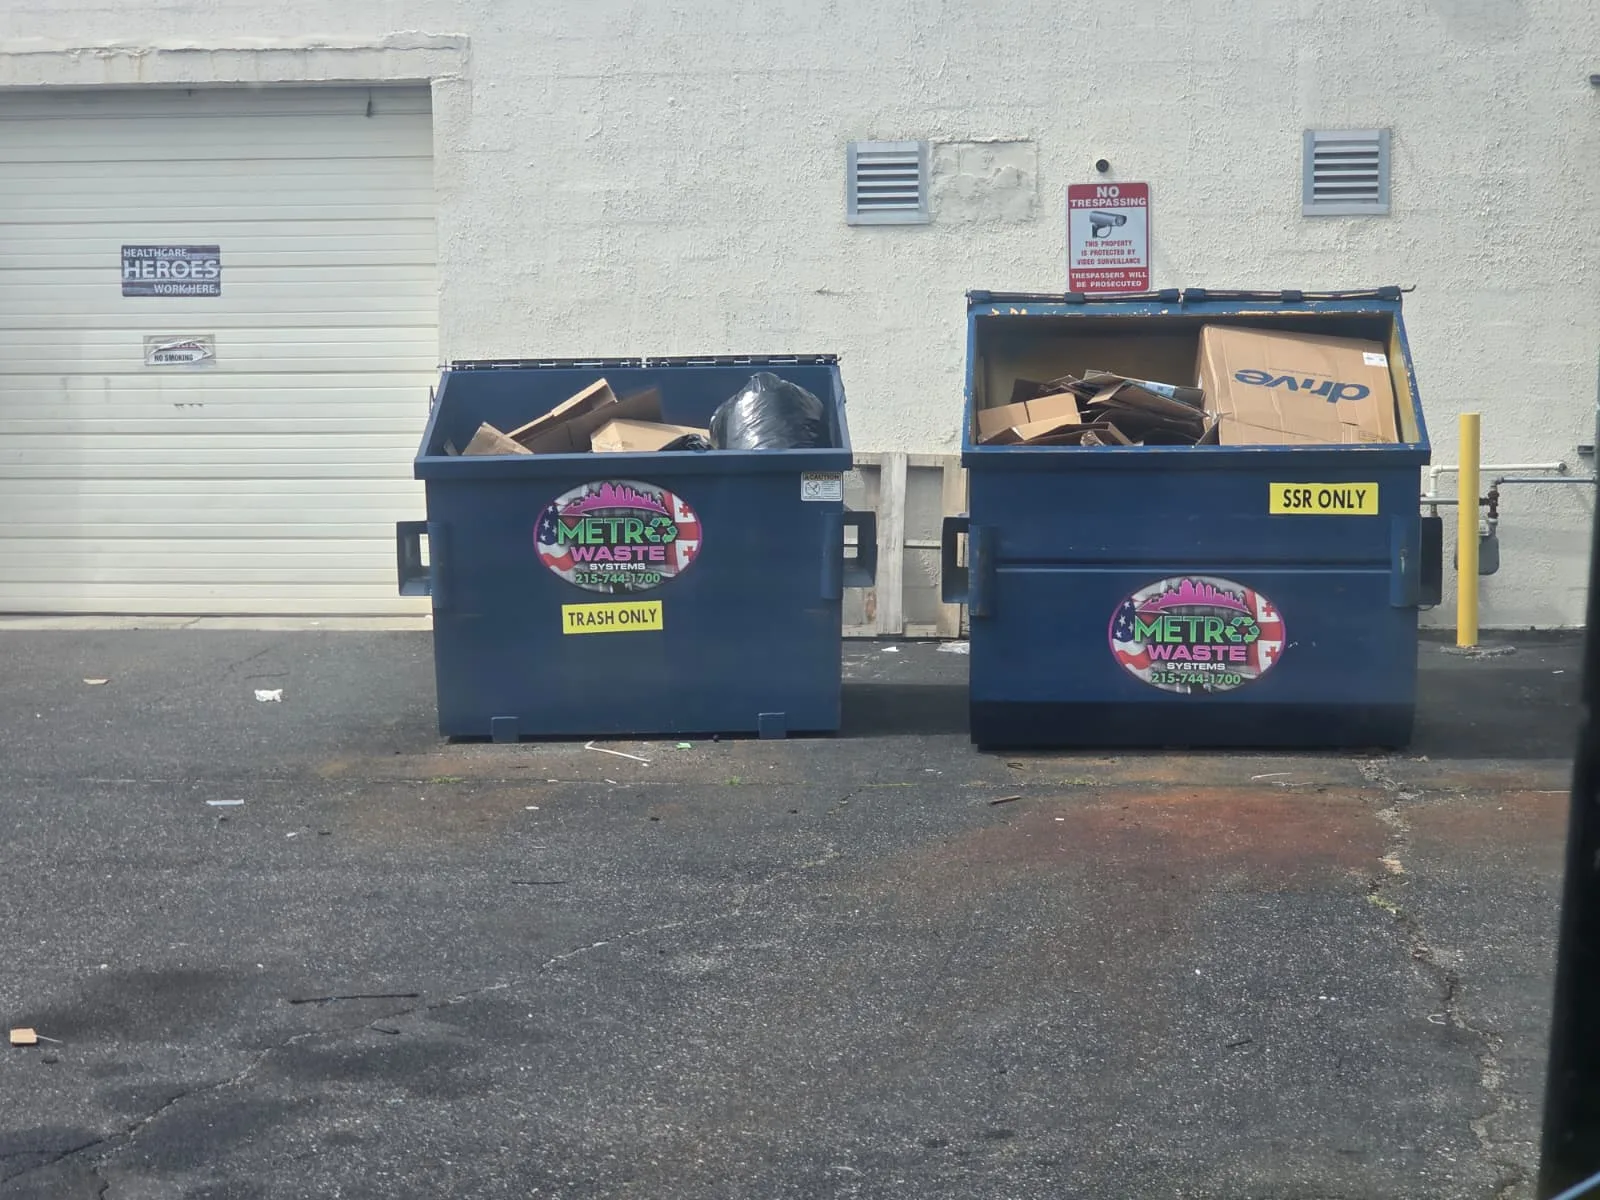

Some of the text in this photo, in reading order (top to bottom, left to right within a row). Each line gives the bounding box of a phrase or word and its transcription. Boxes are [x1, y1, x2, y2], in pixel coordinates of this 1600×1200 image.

[1096, 186, 1120, 198] NO
[1070, 198, 1147, 208] TRESPASSING
[123, 248, 187, 257] HEALTHCARE
[123, 260, 219, 278] HEROES
[153, 284, 187, 294] WORK
[165, 353, 194, 361] SMOKING
[1234, 369, 1370, 403] drive
[1283, 489, 1366, 509] SSR ONLY
[570, 545, 665, 562] WASTE
[589, 562, 646, 571] SYSTEMS
[575, 573, 661, 584] 215-744-1700
[568, 608, 657, 627] TRASH ONLY
[1147, 645, 1247, 662] WASTE
[1166, 662, 1226, 671] SYSTEMS
[1151, 672, 1241, 684] 215-744-1700
